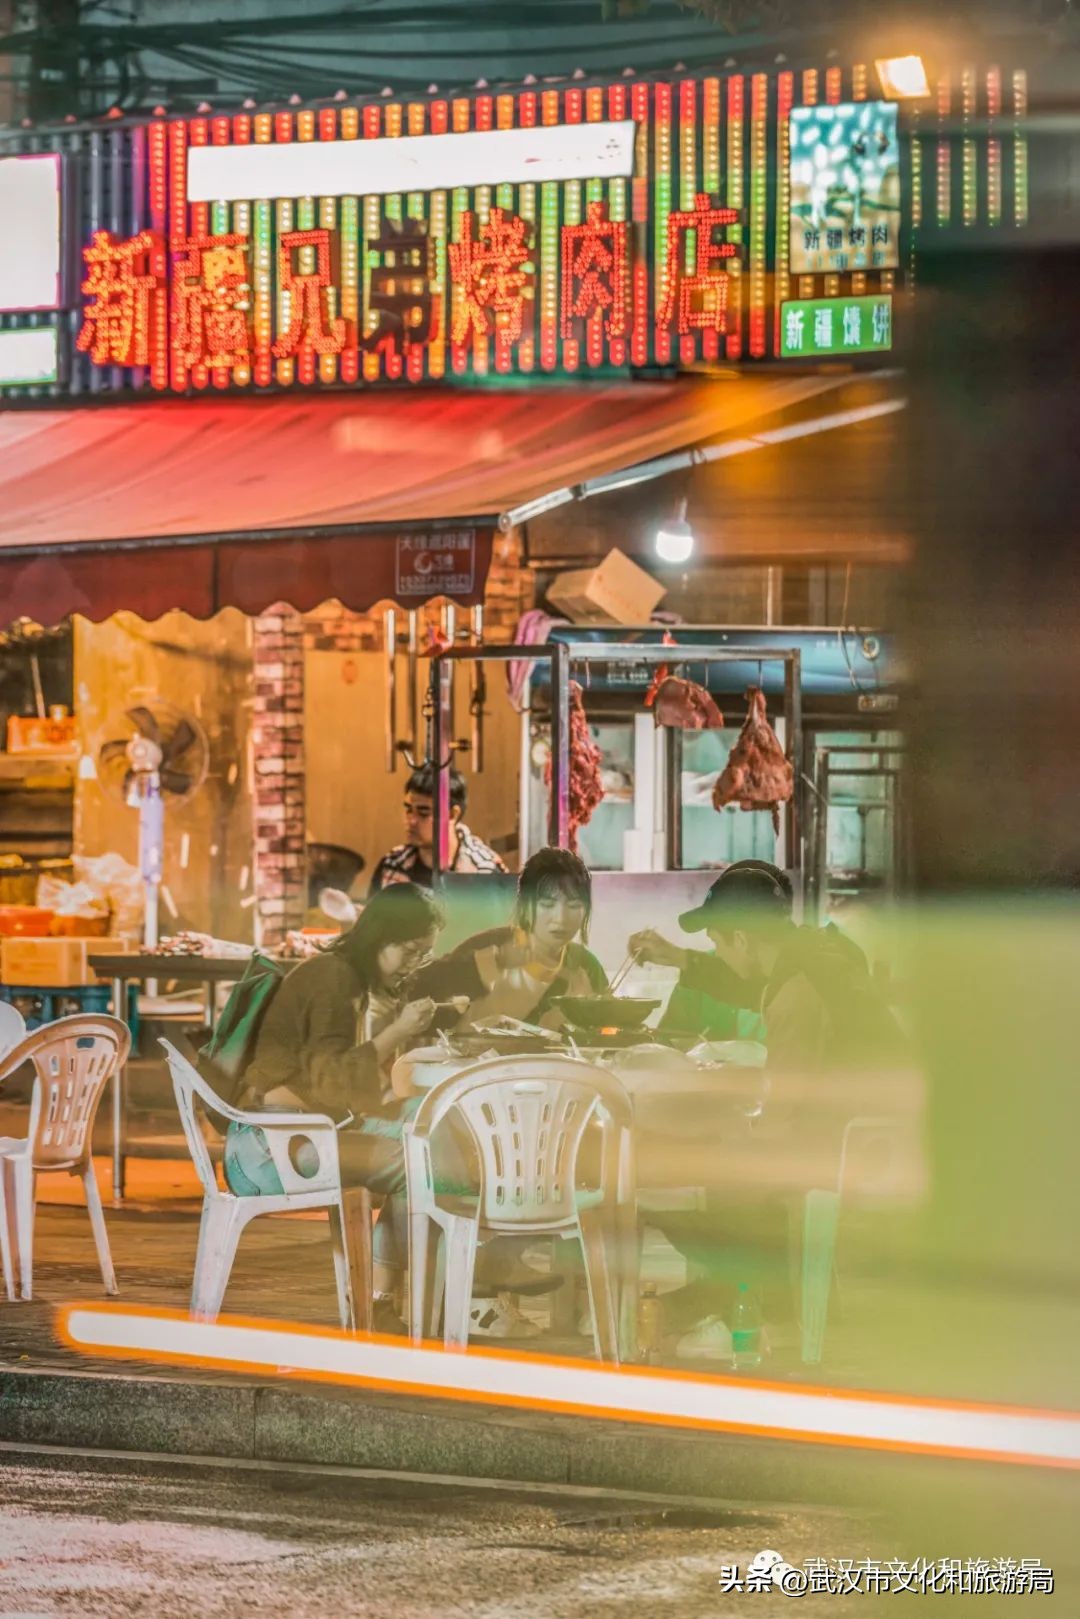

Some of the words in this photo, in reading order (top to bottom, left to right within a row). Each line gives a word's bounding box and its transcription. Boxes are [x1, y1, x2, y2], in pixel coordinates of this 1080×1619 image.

[77, 194, 742, 368] 新疆兄弟烤肉店
[804, 225, 888, 250] 新疆烤肉
